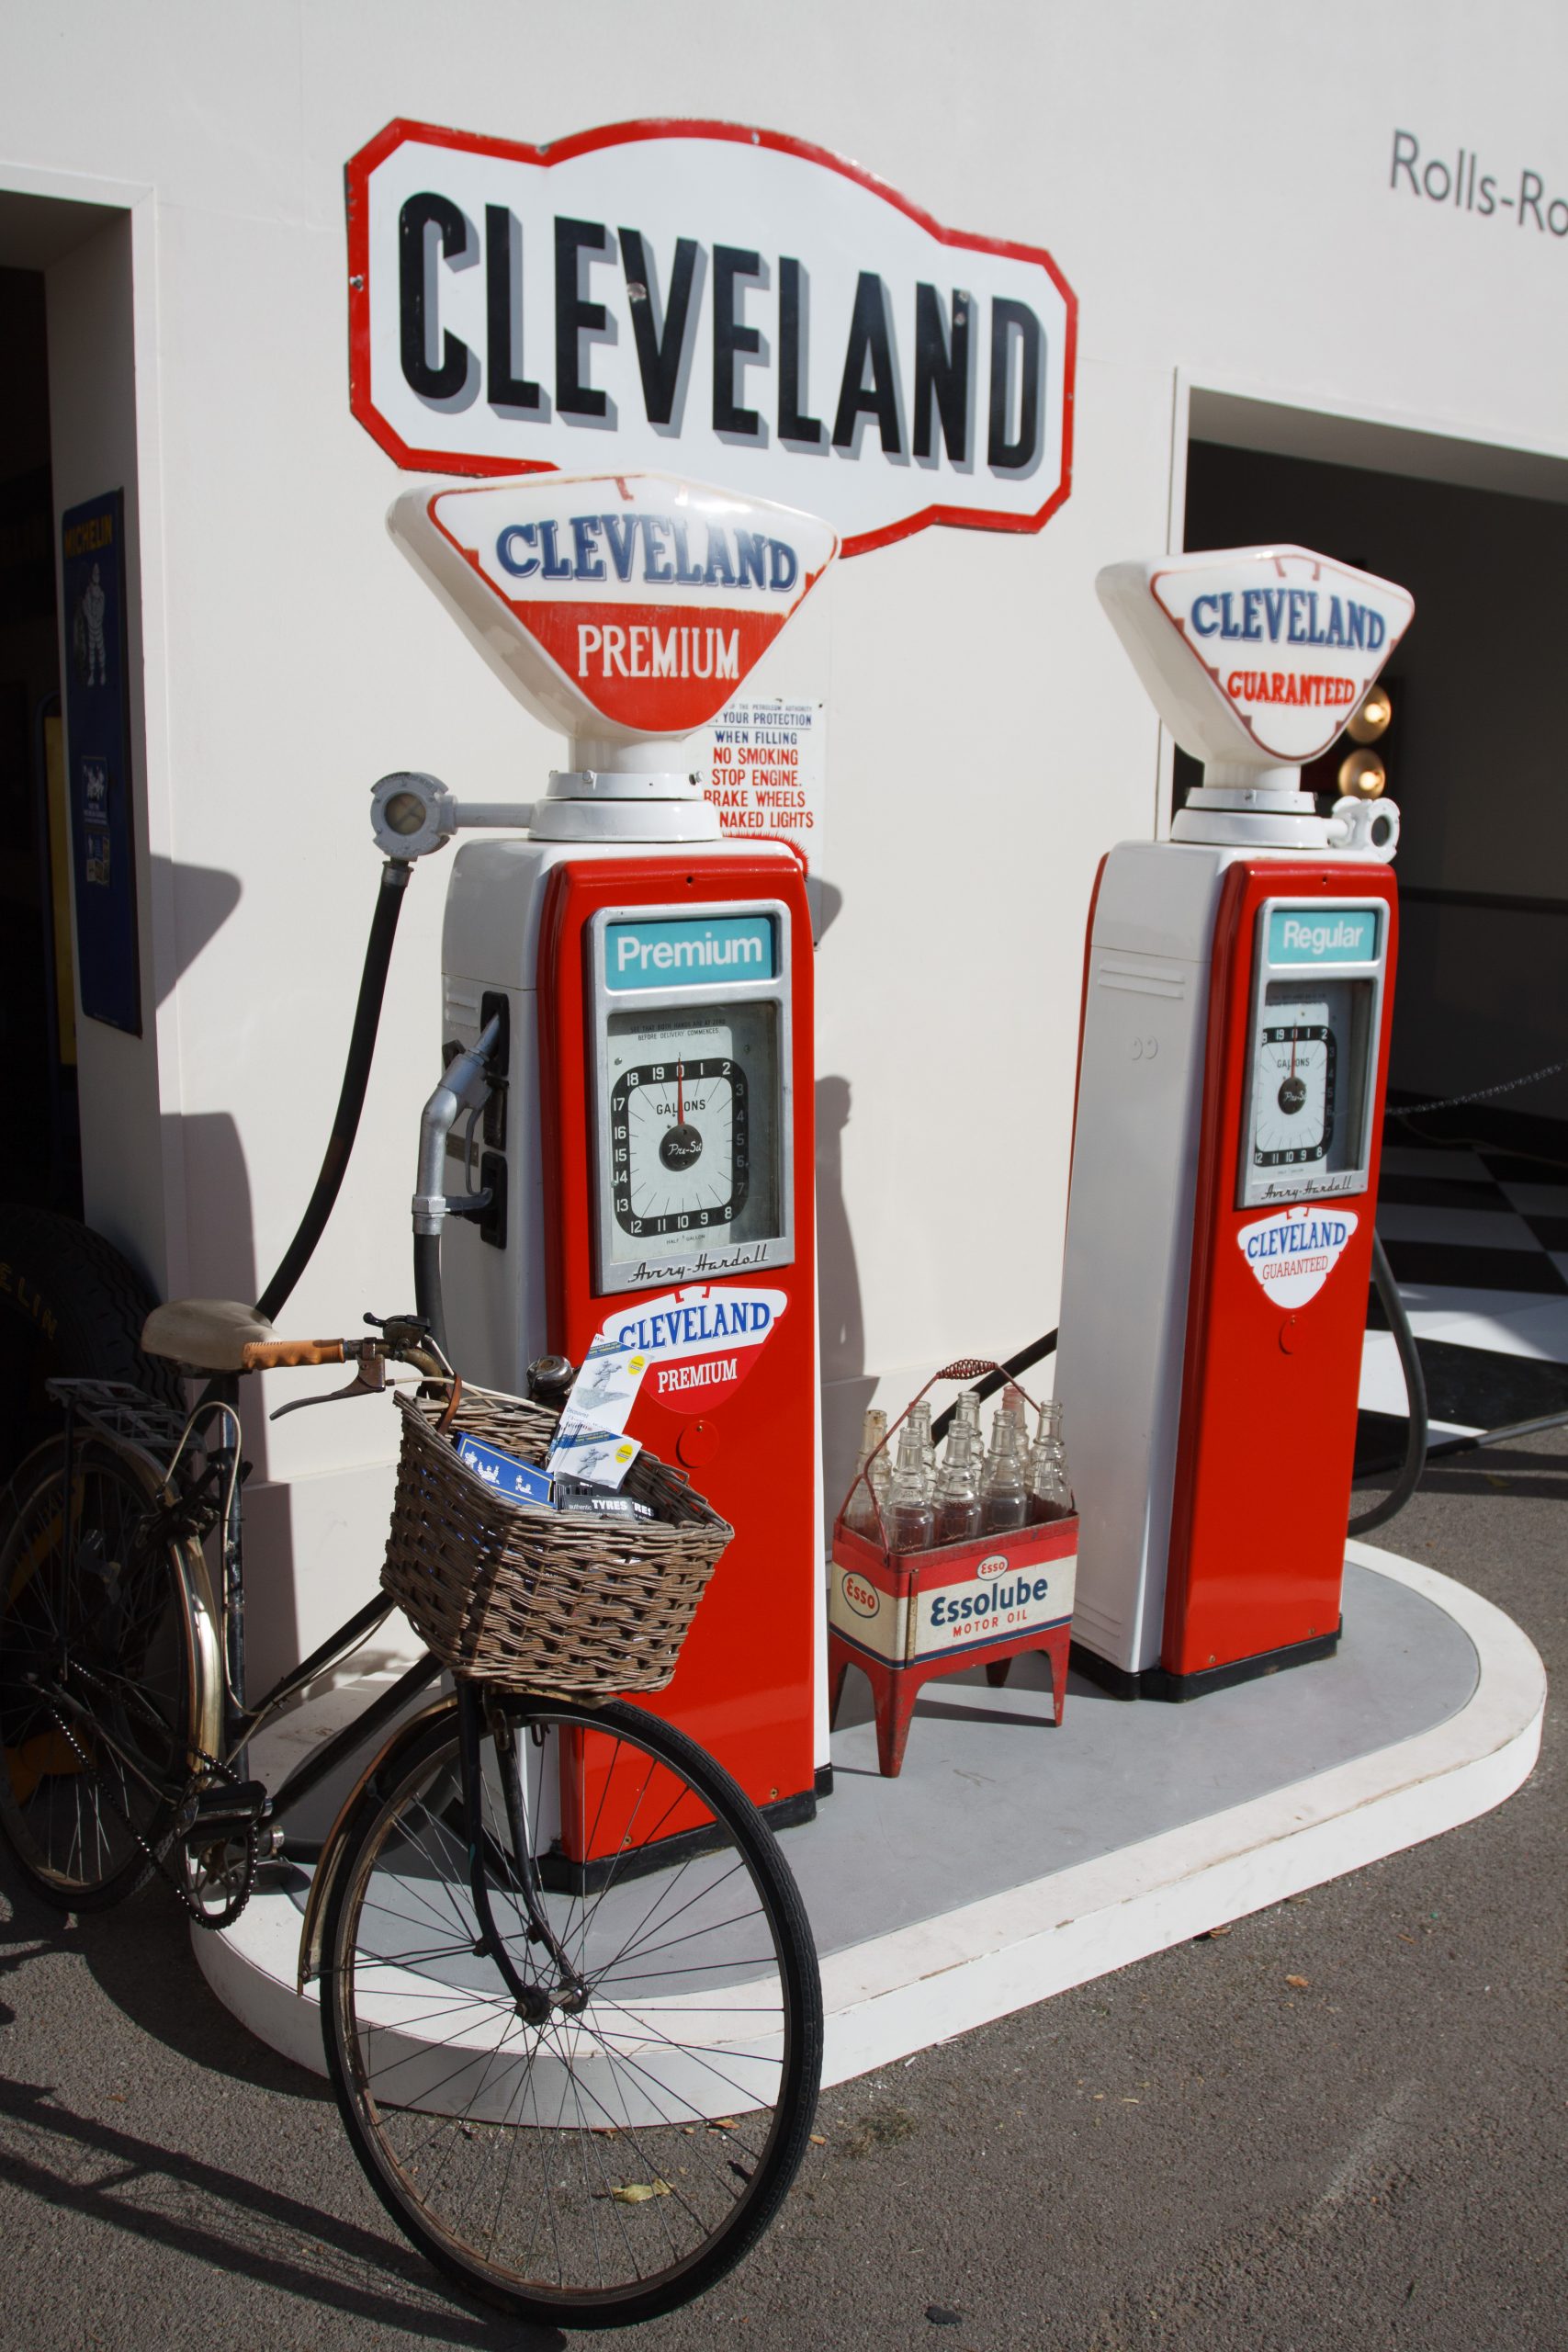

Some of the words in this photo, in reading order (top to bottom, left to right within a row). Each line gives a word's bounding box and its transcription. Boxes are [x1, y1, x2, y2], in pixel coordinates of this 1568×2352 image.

[398, 191, 1045, 478] CLEVELAND
[65, 514, 112, 559] MICHELIN
[495, 514, 798, 593] CLEVELAND
[1190, 588, 1386, 651] CLEVELAND
[577, 624, 740, 681] PREMIUM
[1227, 671, 1356, 707] GUARANTEED
[723, 711, 750, 725] YOUR
[753, 712, 812, 727] PROTECTION
[715, 730, 749, 744] WHEN
[755, 730, 798, 745] FILLING
[713, 747, 732, 764] NO
[738, 748, 798, 765] SMOKING
[712, 768, 745, 786] STOP
[751, 770, 802, 787] ENGINE.
[704, 789, 749, 808] BRAKE
[755, 790, 806, 808] WHEELS
[719, 810, 764, 828] NAKED
[770, 811, 814, 829] LIGHTS
[1283, 921, 1364, 956] Regular
[617, 931, 762, 973] Premium
[660, 1031, 684, 1039] DELIVERY
[1276, 1029, 1285, 1041] 19
[1307, 1028, 1311, 1039] 1
[1321, 1029, 1328, 1040] 2
[1277, 1057, 1311, 1069] GALONS
[626, 1072, 639, 1086] 18
[652, 1067, 665, 1080] 19
[676, 1064, 684, 1078] 0
[700, 1062, 704, 1075] 1
[722, 1062, 731, 1075] 2
[736, 1083, 744, 1096] 3
[613, 1097, 626, 1112] 17
[656, 1099, 706, 1115] GALONS
[737, 1110, 744, 1122] 4
[615, 1125, 626, 1140] 16
[737, 1134, 745, 1146] 5
[615, 1148, 627, 1162] 15
[668, 1141, 702, 1156] Pre-Set
[1255, 1152, 1263, 1164] 12
[1272, 1153, 1279, 1164] 11
[1286, 1151, 1294, 1162] 10
[1301, 1149, 1307, 1161] 9
[1316, 1146, 1323, 1158] 8
[737, 1156, 745, 1168] 6
[615, 1170, 628, 1183] 14
[737, 1182, 746, 1194] 7
[1261, 1175, 1353, 1201] Avery-Hardoll
[616, 1198, 629, 1212] 13
[630, 1220, 642, 1234] 12
[658, 1218, 666, 1232] 11
[677, 1216, 689, 1228] 10
[700, 1212, 708, 1226] 9
[724, 1206, 732, 1219] 8
[686, 1234, 705, 1242] GALLON
[1247, 1222, 1347, 1259] CLEVELAND
[628, 1243, 770, 1283] Avery-Hardoll
[1262, 1255, 1329, 1281] GUARANTEED
[619, 1300, 772, 1351] CLEVELAND
[657, 1358, 738, 1395] PREMIUM
[570, 1502, 592, 1511] authentic
[592, 1498, 628, 1511] TYRES
[980, 1558, 1006, 1575] Esso
[846, 1576, 875, 1610] Esso
[931, 1576, 1048, 1627] Essolube
[953, 1616, 998, 1637] MOTOR
[1007, 1610, 1028, 1624] OIL
